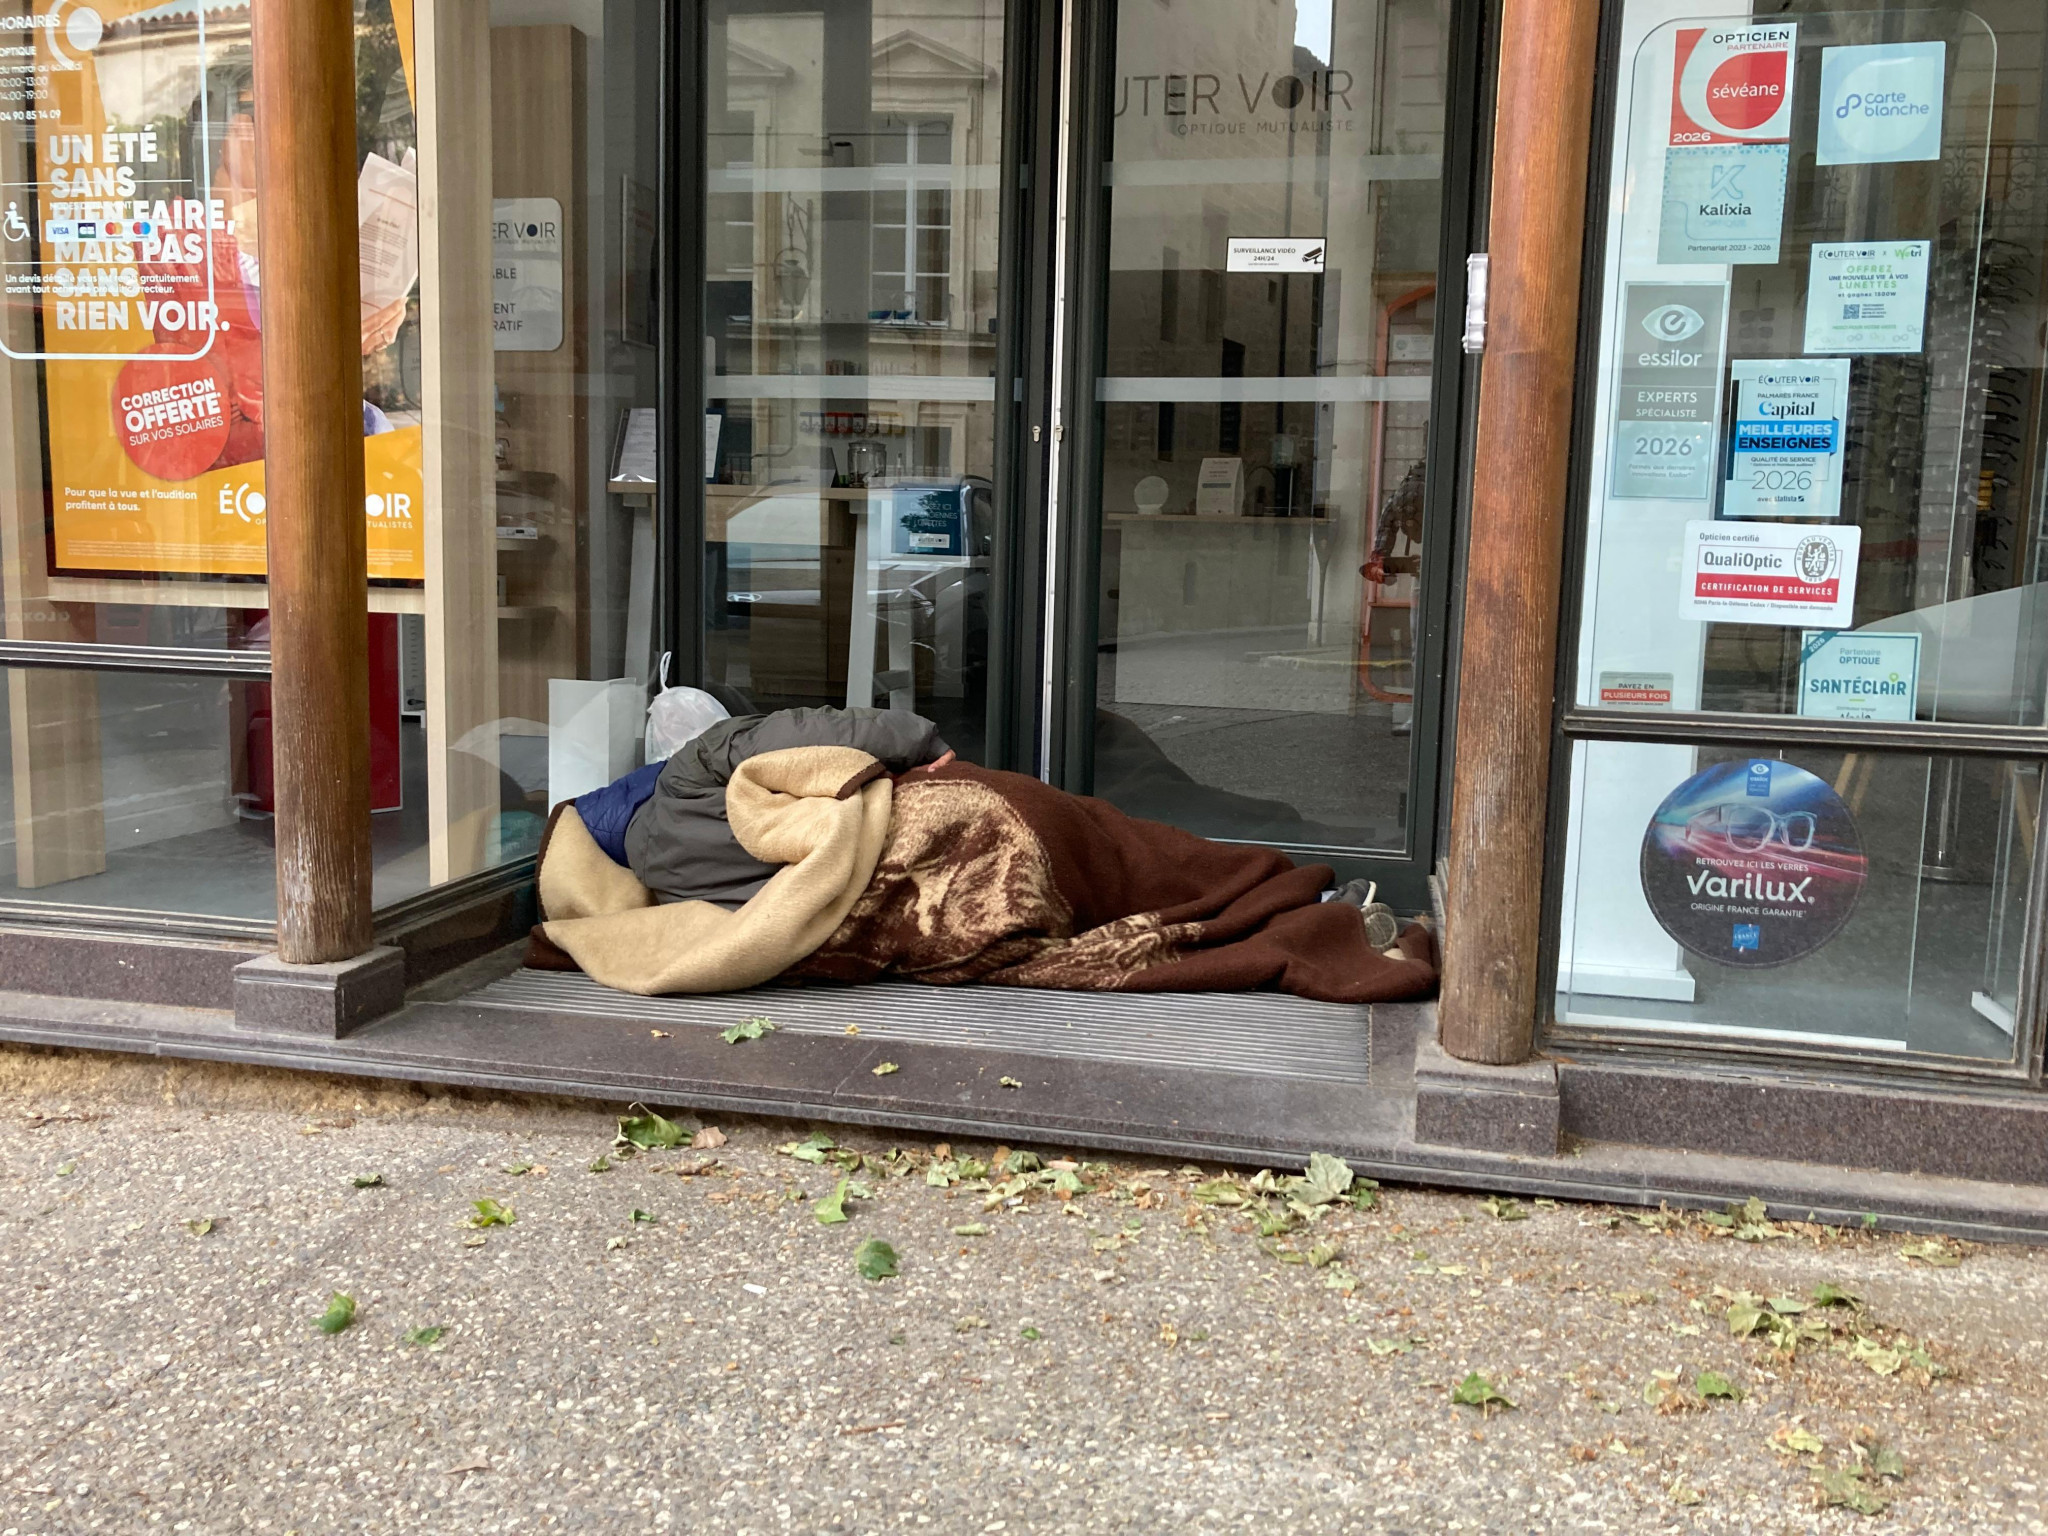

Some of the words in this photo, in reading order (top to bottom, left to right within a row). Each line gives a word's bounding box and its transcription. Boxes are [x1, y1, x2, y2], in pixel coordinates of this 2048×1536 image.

[1713, 31, 1790, 44] OPTICIEN
[1727, 42, 1789, 51] PARTENAIRE
[1237, 70, 1354, 115] VOIR
[1712, 82, 1780, 99] sévéane
[0, 111, 12, 121] 04
[12, 111, 25, 121] 90
[25, 110, 37, 120] 85
[38, 110, 48, 119] 14
[49, 109, 61, 119] 09
[1864, 103, 1930, 117] blanche
[1177, 122, 1247, 136] OPTIQUE
[1256, 119, 1353, 133] MUTUALISTE
[1672, 132, 1712, 143] 2026
[50, 134, 94, 164] UN
[102, 125, 159, 163] ÉTÉ
[50, 166, 137, 199] SANS
[1699, 203, 1752, 216] Kalixia
[133, 199, 236, 235] FAIRE,
[52, 227, 70, 235] VISA
[513, 222, 556, 239] VOIR
[142, 234, 204, 264] PAS
[1688, 244, 1728, 252] Partenariat
[1846, 264, 1893, 274] OFFREZ
[5, 274, 17, 283] Un
[18, 273, 41, 283] devis
[140, 274, 199, 285] gratuitement
[5, 285, 31, 294] avant
[32, 285, 50, 294] tout
[1838, 280, 1897, 290] LUNETTES
[493, 302, 516, 315] ENT
[56, 300, 130, 331] RIEN
[137, 300, 231, 332] VOIR.
[1638, 349, 1703, 367] essilor
[1758, 375, 1798, 385] ÉCOUTER
[1799, 375, 1820, 384] VOIR
[120, 377, 216, 411] CORRECTION
[1637, 391, 1698, 403] EXPERTS
[1635, 407, 1697, 418] SPÉCIALISTE
[1758, 401, 1815, 420] Capital
[129, 432, 151, 446] SUR
[151, 427, 174, 441] VOS
[174, 415, 224, 436] SOLAIRES
[1738, 424, 1833, 436] MEILLEURES
[1634, 437, 1693, 456] 2026
[1738, 436, 1832, 449] ENSEIGNES
[1751, 470, 1812, 491] 2026
[65, 486, 87, 497] Pour
[88, 489, 107, 499] que
[108, 487, 118, 498] la
[120, 489, 138, 498] vue
[140, 488, 150, 499] et
[151, 488, 198, 500] l'audition
[65, 500, 107, 512] profitent
[108, 500, 115, 511] à
[117, 501, 141, 512] tous.
[365, 493, 412, 519] OIR
[1699, 533, 1731, 542] Opticien
[1732, 534, 1760, 543] certifié
[1703, 551, 1783, 572] QualiOptic
[1701, 582, 1769, 593] CERTIFICATION
[1772, 585, 1784, 594] DE
[1787, 586, 1833, 596] SERVICES
[1839, 647, 1882, 656] Partenaire
[1839, 656, 1881, 665] OPTIQUE
[1810, 674, 1907, 696] SANTÉCLAIR
[1603, 691, 1647, 699] PLUSIEURS
[1648, 692, 1668, 700] FOIS
[1695, 857, 1745, 868] RETROUVEZ
[1746, 860, 1758, 869] ICI
[1760, 861, 1775, 870] LES
[1777, 863, 1809, 872] VERRES
[1690, 902, 1725, 913] ORIGINE
[1727, 905, 1760, 915] FRANCE
